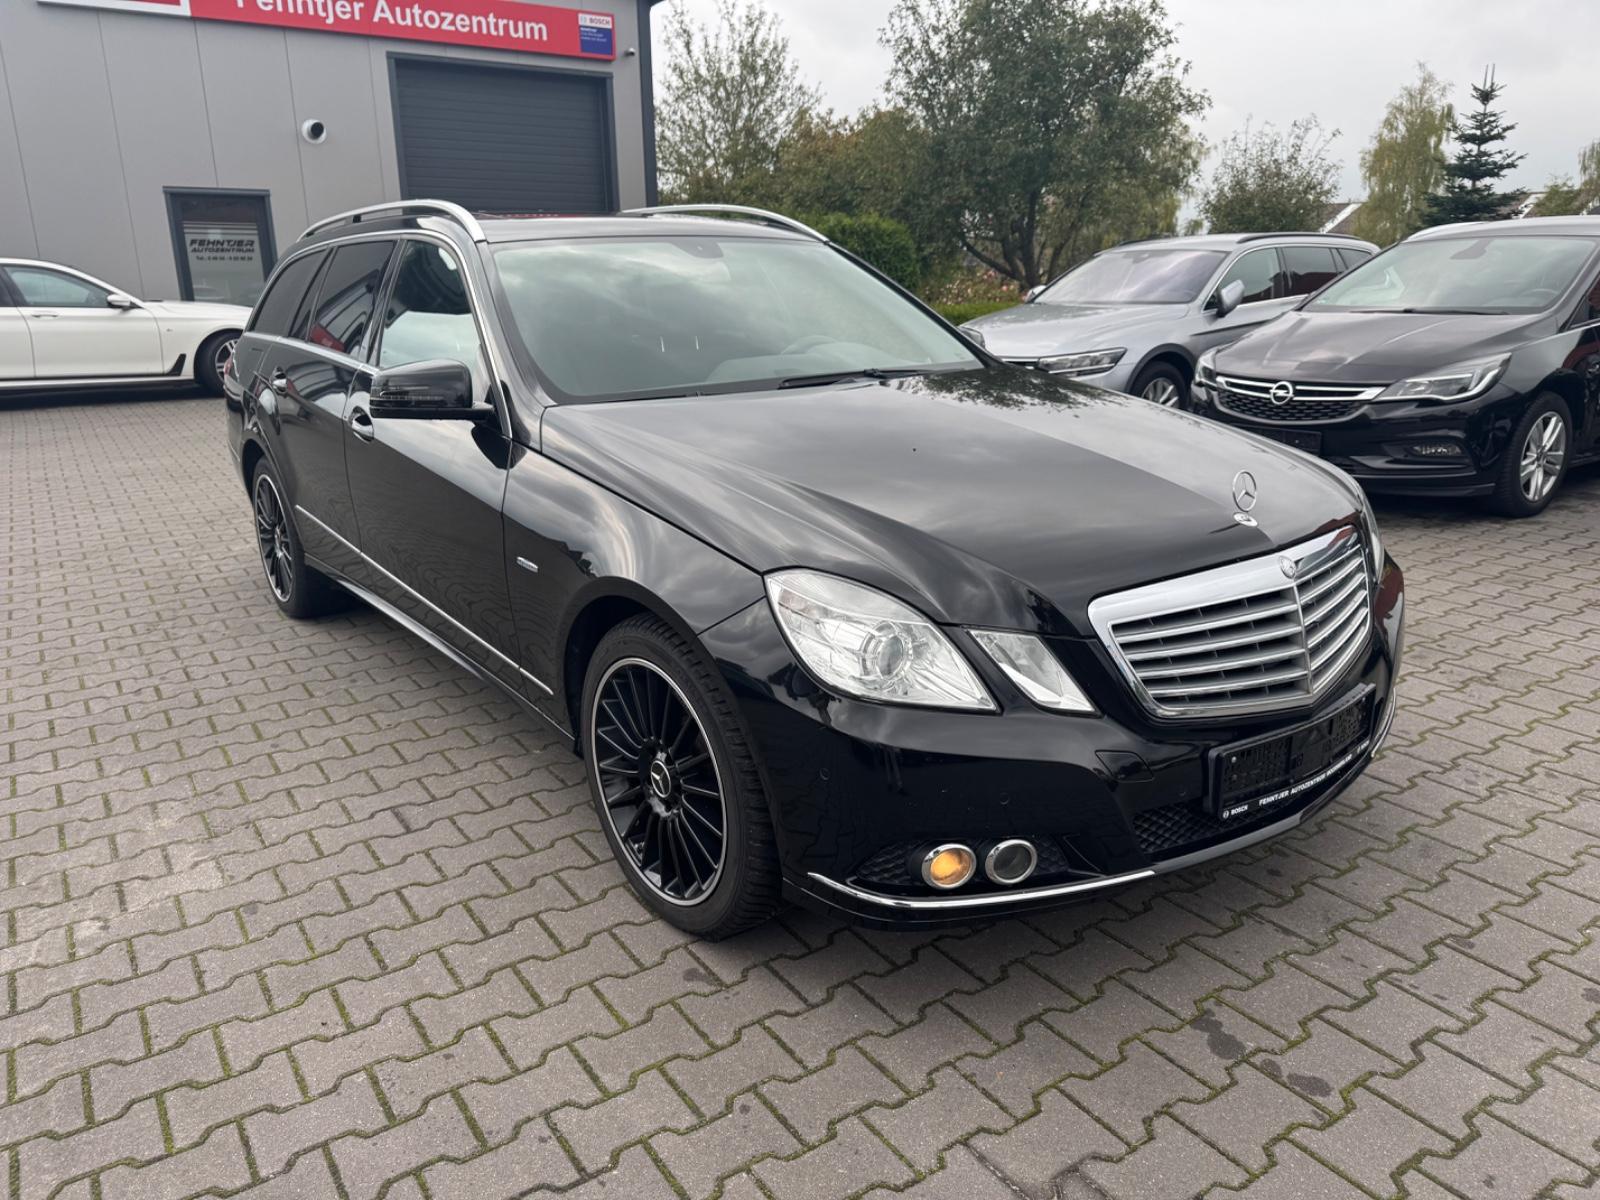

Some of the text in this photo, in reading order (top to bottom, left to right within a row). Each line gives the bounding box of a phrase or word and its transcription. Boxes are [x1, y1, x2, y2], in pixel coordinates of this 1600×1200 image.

[236, 0, 364, 24] entjer
[371, 0, 548, 41] Autozentrum
[189, 239, 255, 247] FEHNTJER
